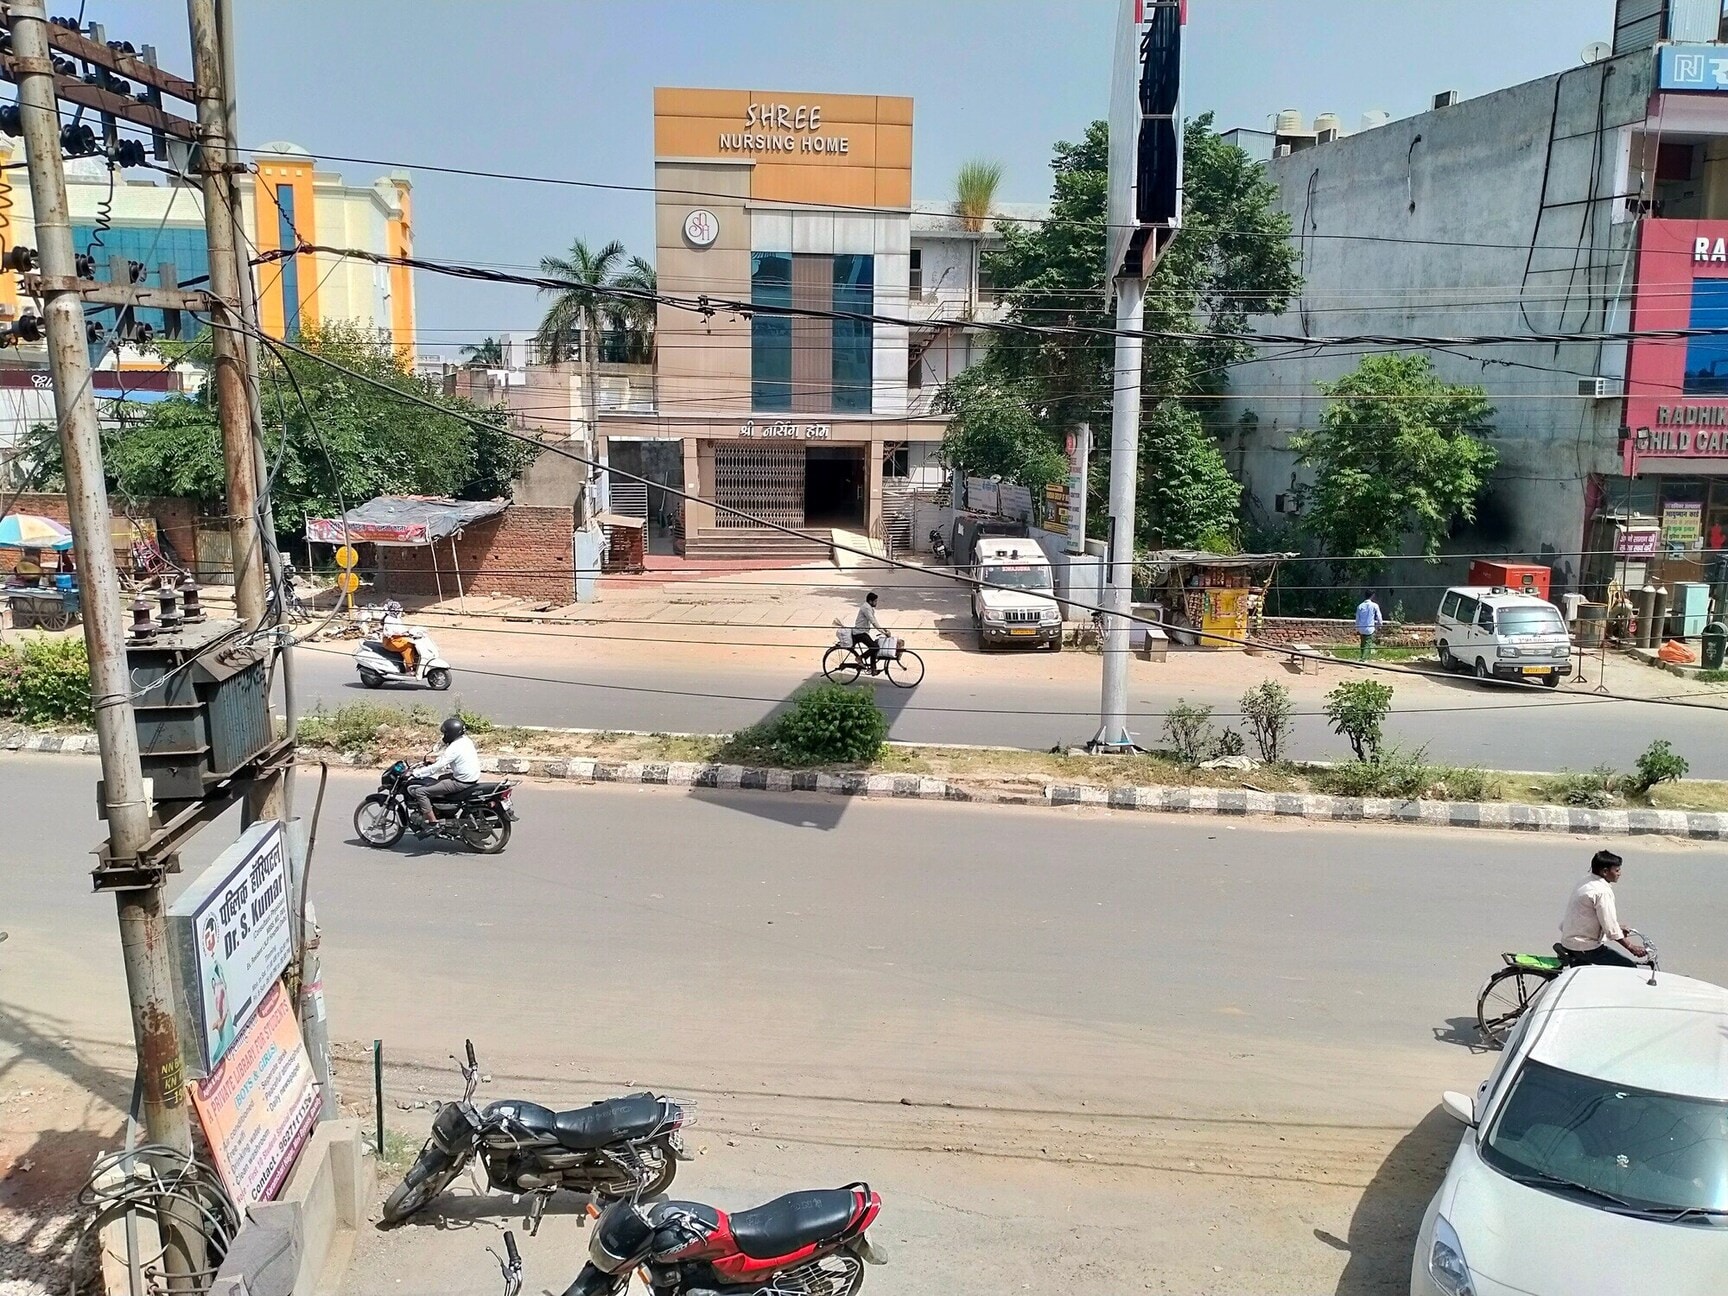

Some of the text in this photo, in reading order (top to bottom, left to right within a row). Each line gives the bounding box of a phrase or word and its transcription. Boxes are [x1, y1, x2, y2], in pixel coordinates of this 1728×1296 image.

[745, 102, 822, 130] SHREE
[720, 133, 849, 152] NURSING HOME
[740, 419, 755, 437] श्री
[219, 878, 248, 927] पब्लिक
[249, 841, 280, 893] हॉस्पिटल
[224, 927, 239, 960] Dr.
[239, 911, 250, 940] S.
[251, 872, 282, 927] Kumar
[210, 1075, 235, 1116] PRIVATE
[233, 1044, 255, 1084] LIBRARY
[254, 1029, 266, 1053] FOR
[263, 997, 288, 1040] STUDENTS
[252, 1066, 259, 1081] &
[250, 1154, 276, 1201] Contact
